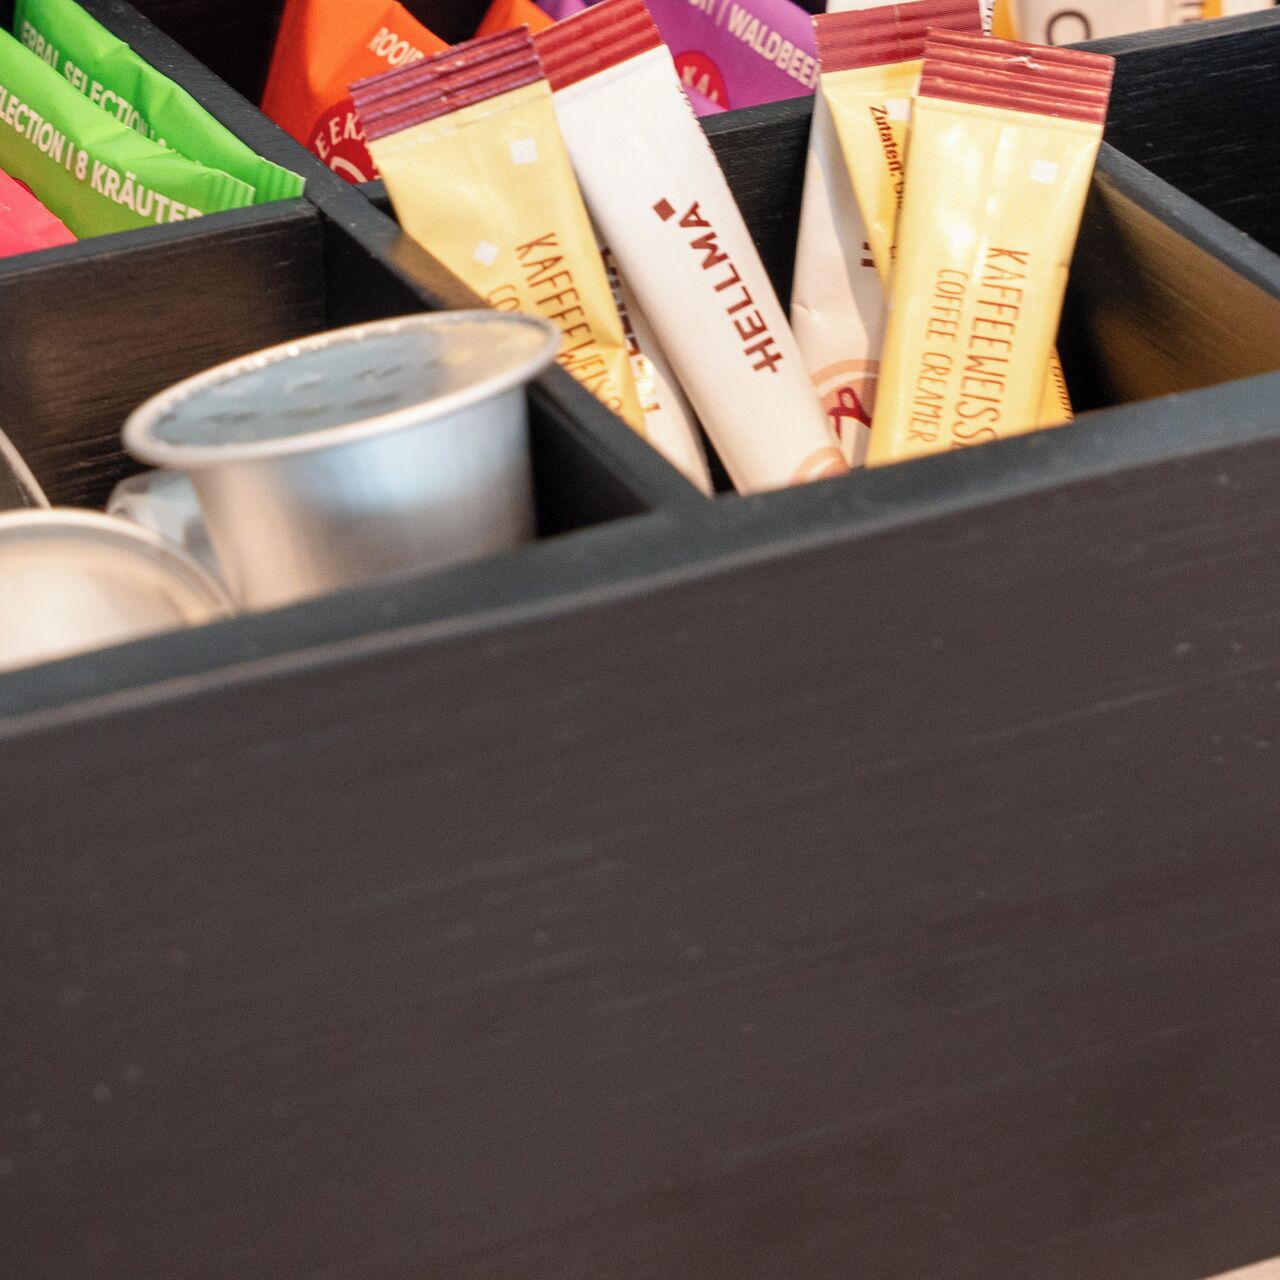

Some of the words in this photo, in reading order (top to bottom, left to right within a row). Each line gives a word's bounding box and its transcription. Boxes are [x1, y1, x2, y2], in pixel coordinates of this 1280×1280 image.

[74, 150, 89, 181] 8
[679, 200, 783, 373] HELLMA
[926, 268, 970, 342] COFFEE
[907, 351, 954, 442] CREAMER
